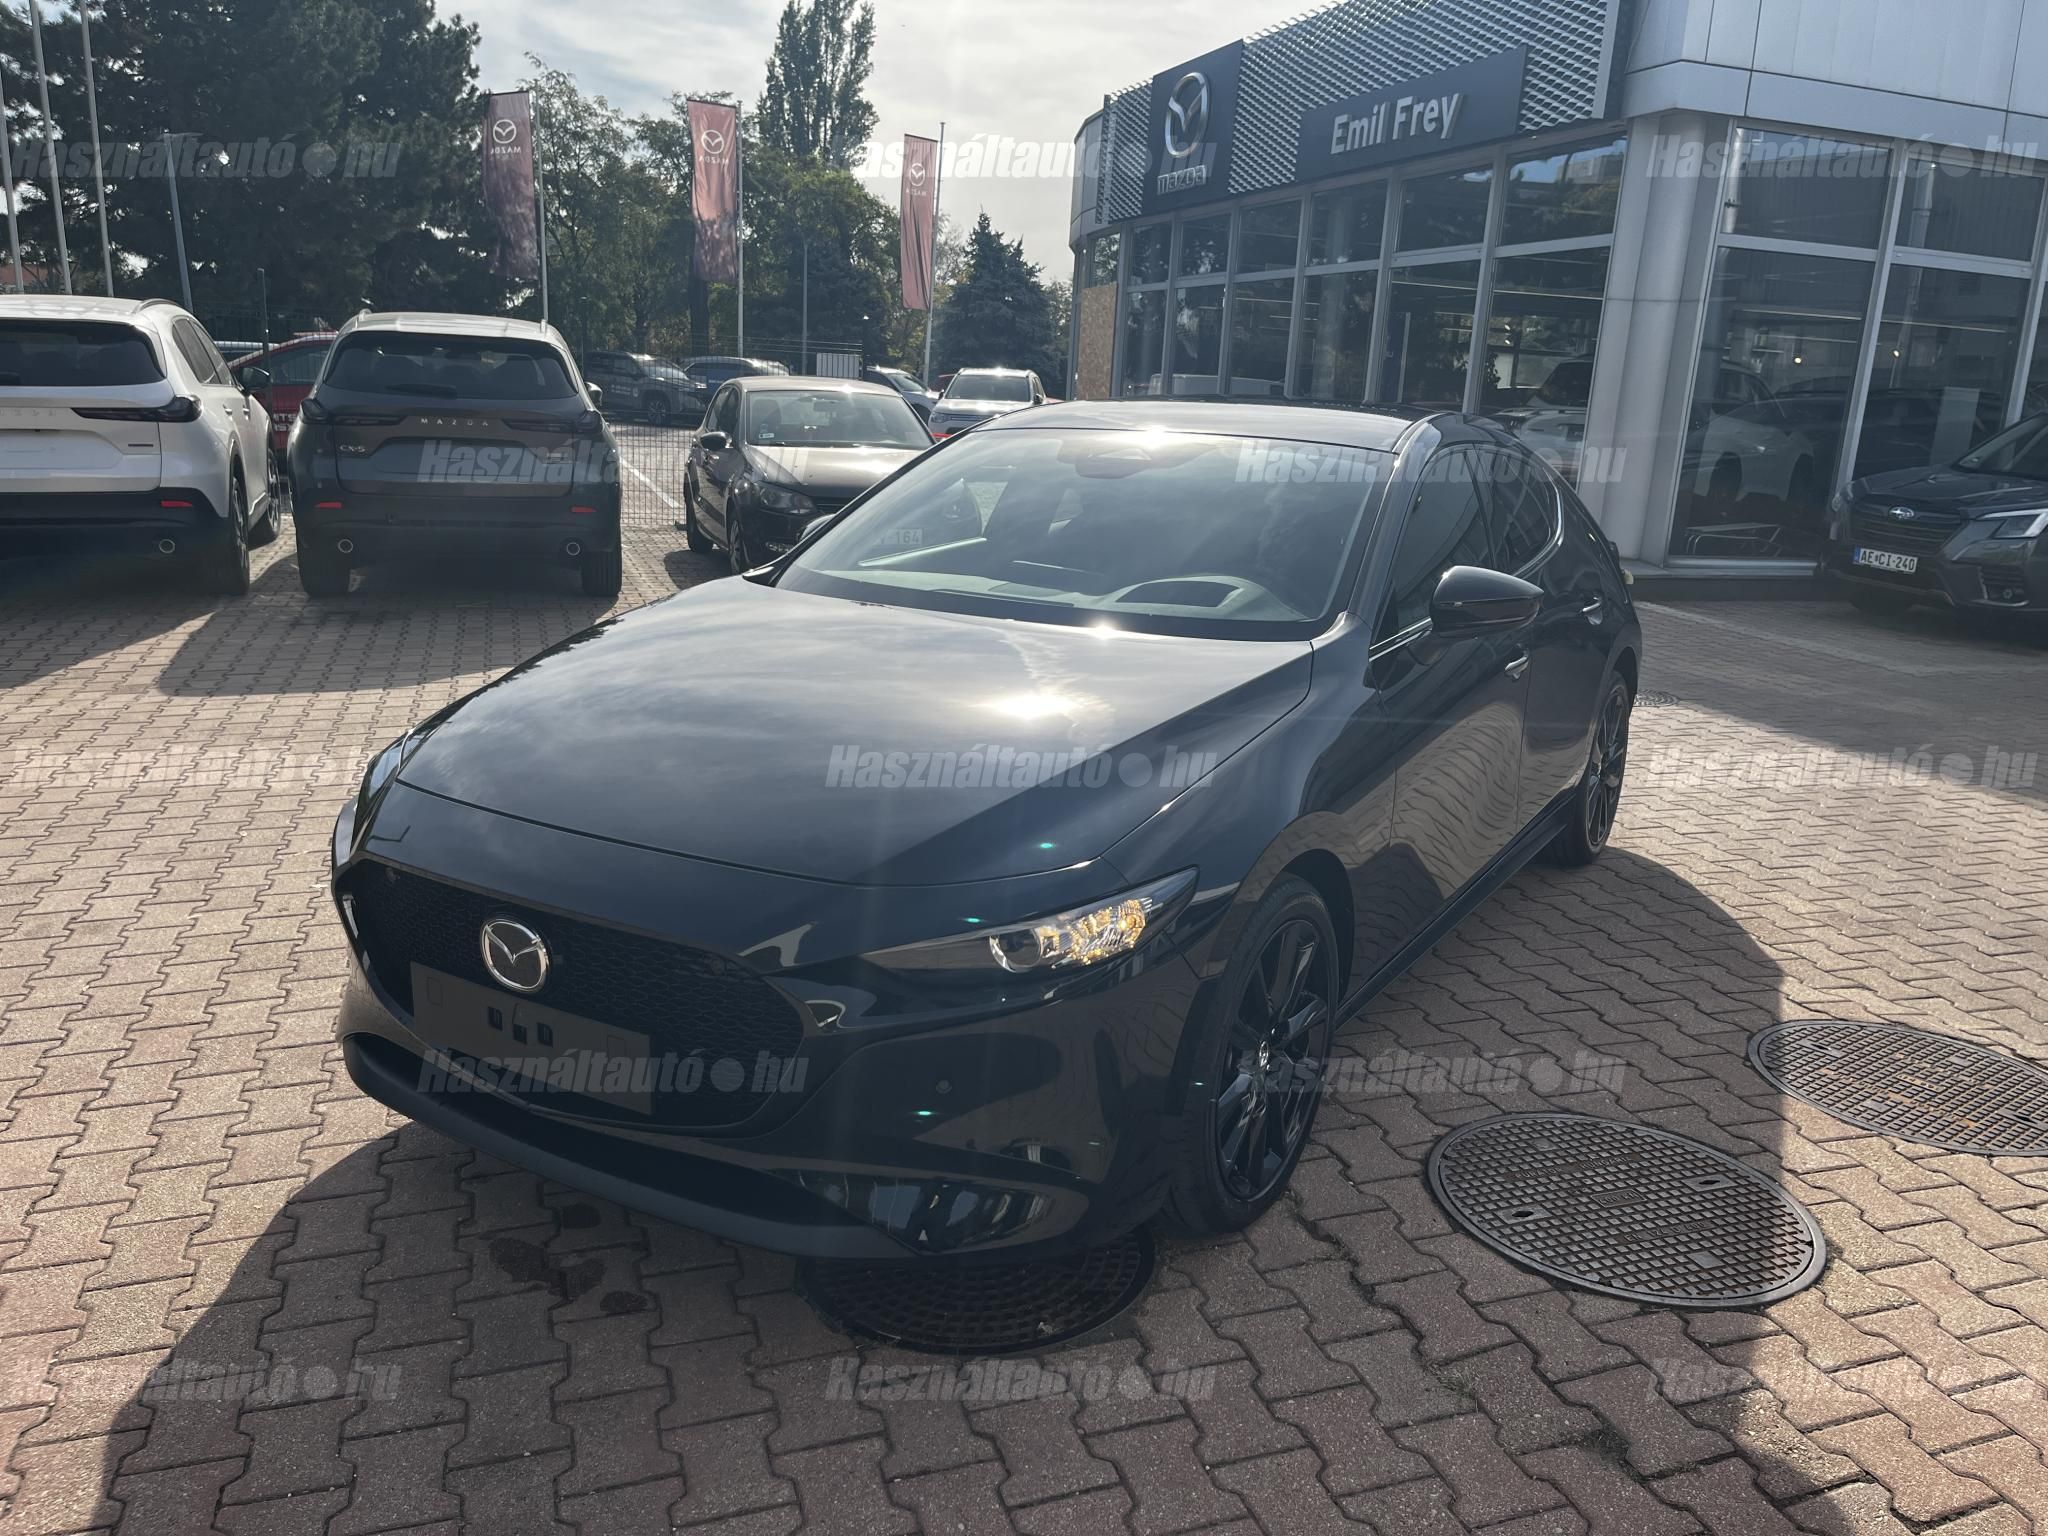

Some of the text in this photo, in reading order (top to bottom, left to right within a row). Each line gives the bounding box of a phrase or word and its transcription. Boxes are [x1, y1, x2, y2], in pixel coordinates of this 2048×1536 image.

[1331, 93, 1462, 155] Emil Frey
[1156, 164, 1207, 196] mazda
[420, 417, 488, 427] MAZDA
[339, 445, 366, 453] CX-5
